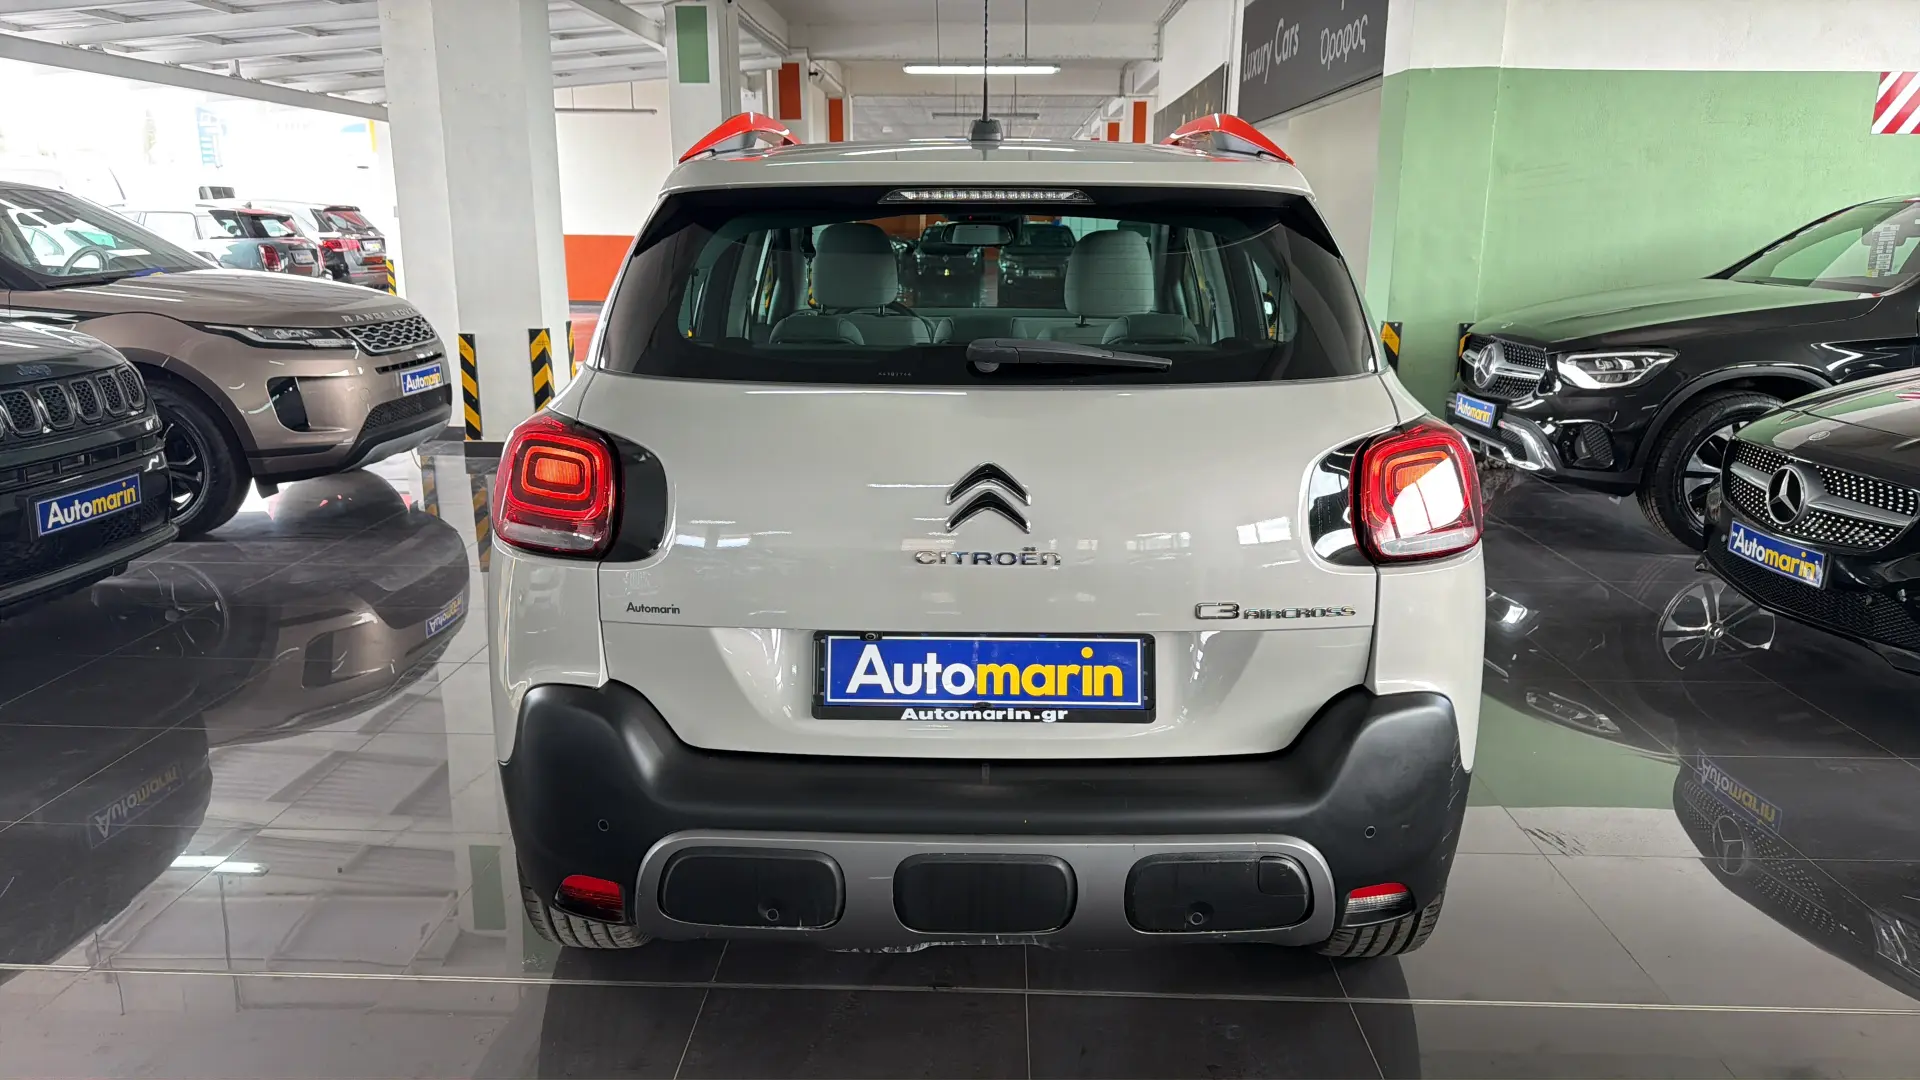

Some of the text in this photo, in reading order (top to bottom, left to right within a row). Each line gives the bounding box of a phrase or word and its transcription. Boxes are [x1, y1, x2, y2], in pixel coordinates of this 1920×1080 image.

[1243, 18, 1299, 84] Luxury Cars
[341, 311, 386, 322] RANGE
[17, 363, 52, 376] Jeep
[47, 482, 137, 529] Automarin
[1733, 528, 1816, 579] Automarin
[626, 602, 680, 614] Automarin
[1195, 602, 1357, 619] C3 AIRCROSS
[845, 644, 1123, 697] Automarin
[900, 707, 1068, 722] Automarin.gr
